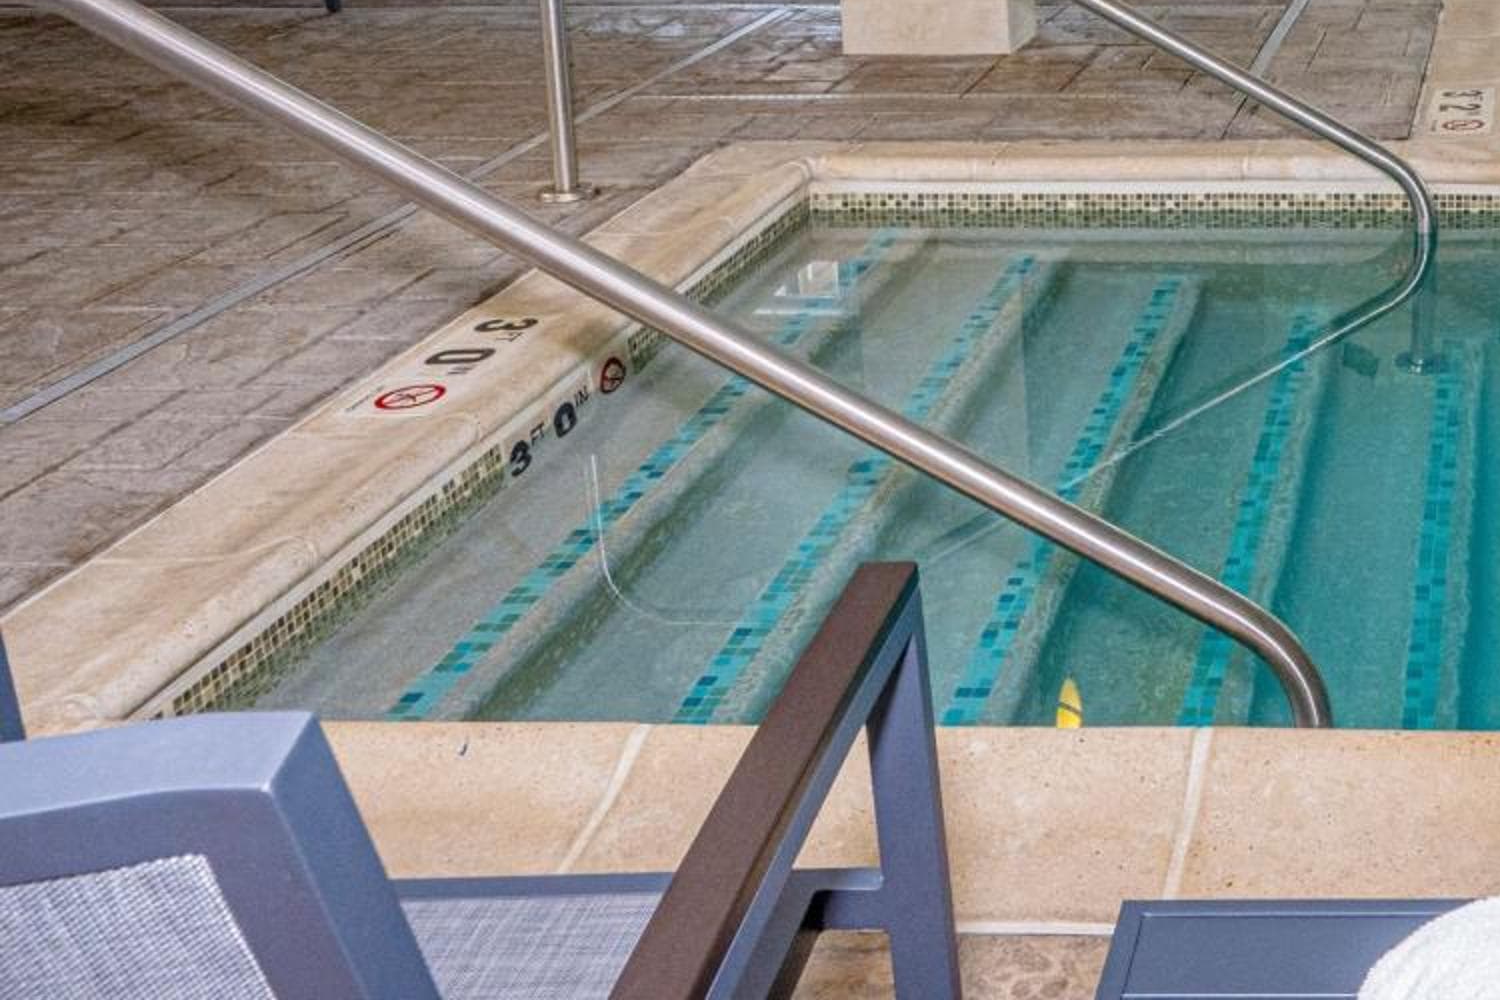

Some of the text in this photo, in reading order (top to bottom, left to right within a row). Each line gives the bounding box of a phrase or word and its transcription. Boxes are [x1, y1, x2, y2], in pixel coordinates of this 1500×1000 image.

[474, 318, 538, 332] 3
[510, 440, 532, 477] 3
[530, 421, 545, 446] FT
[554, 402, 577, 438] 0
